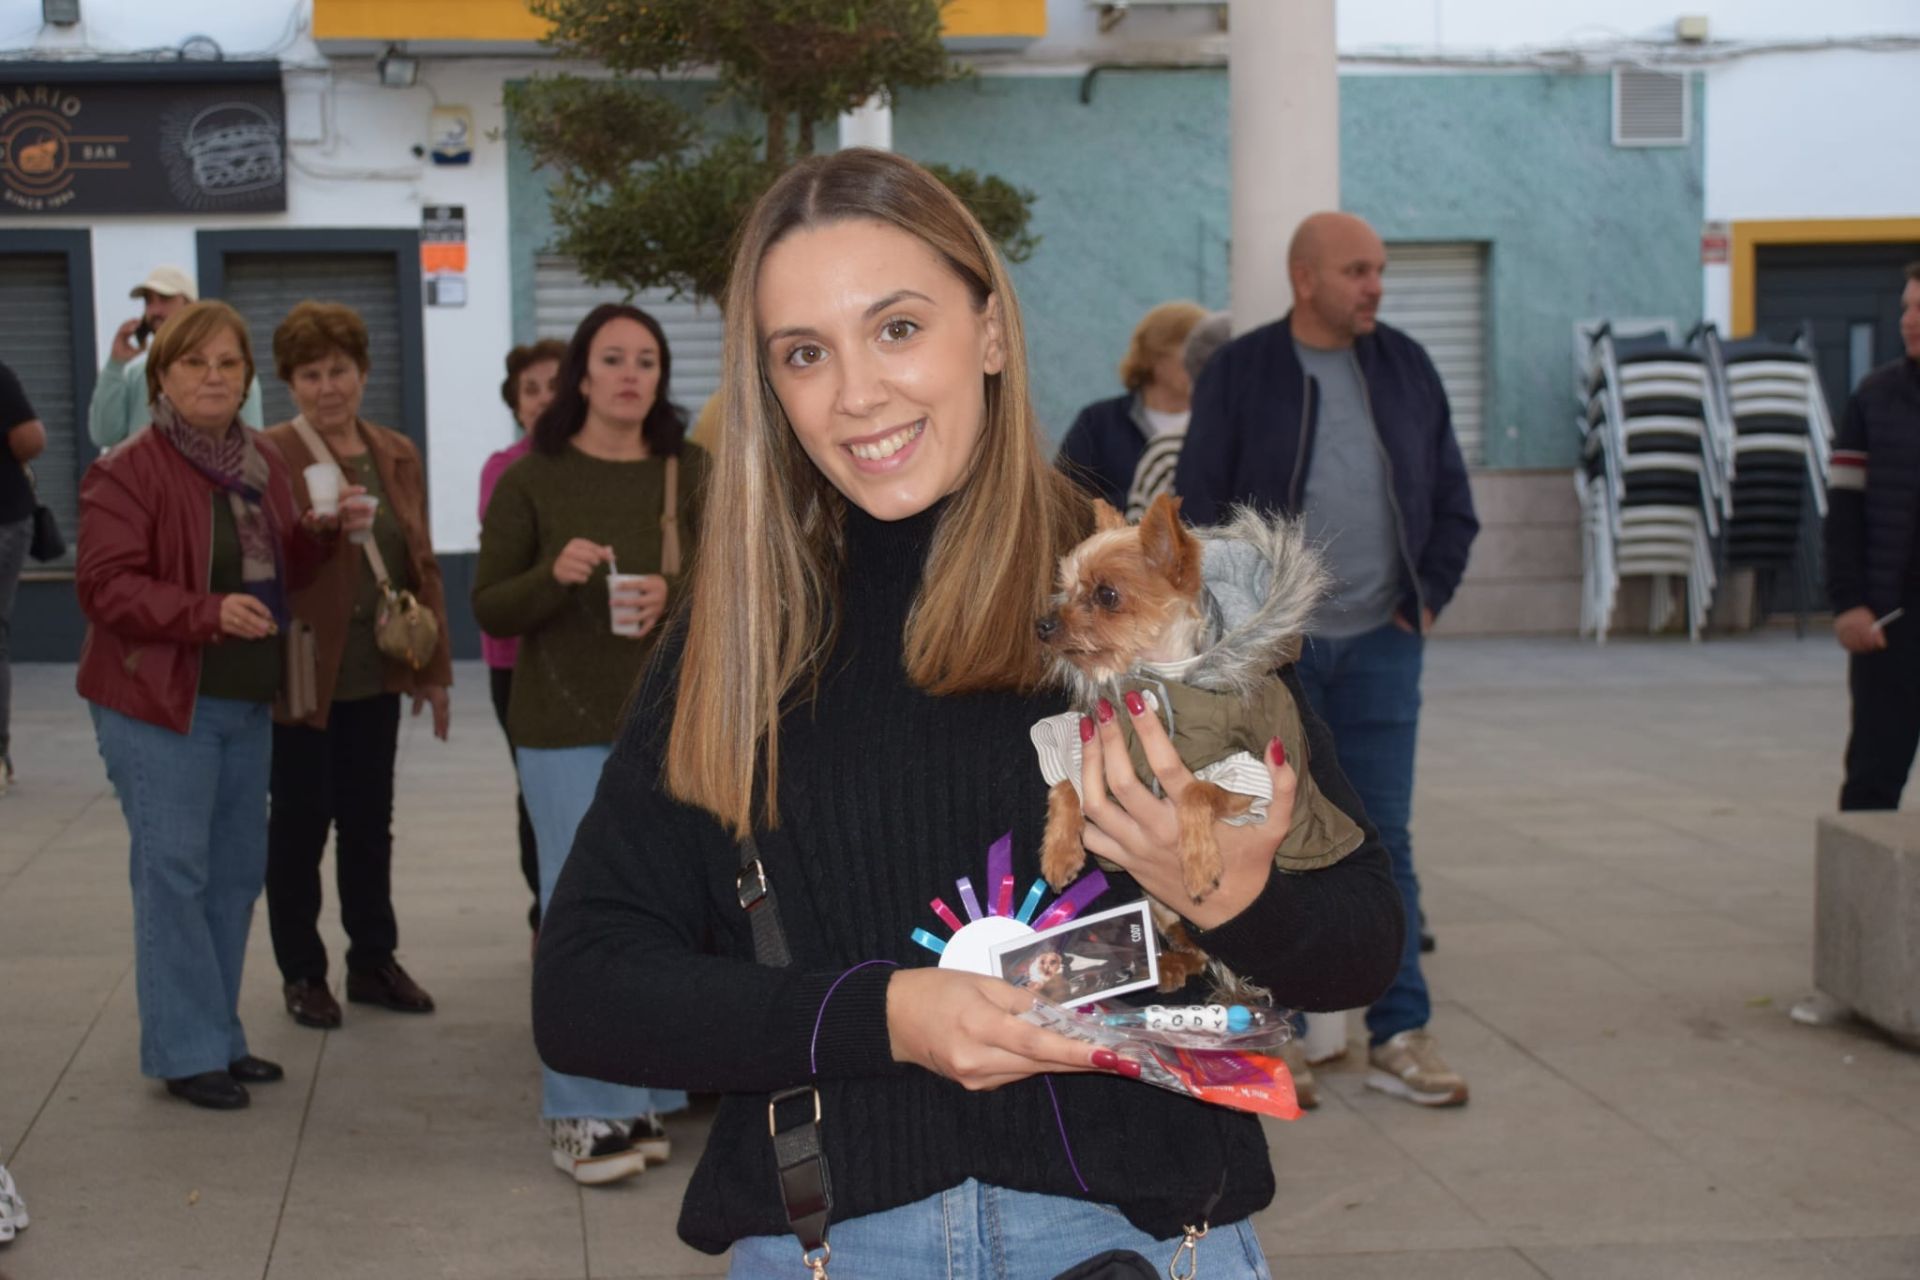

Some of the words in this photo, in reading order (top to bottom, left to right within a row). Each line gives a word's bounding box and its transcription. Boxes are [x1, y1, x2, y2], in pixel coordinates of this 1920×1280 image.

[82, 144, 117, 160] BAR
[1130, 924, 1142, 943] CODY
[1151, 1013, 1223, 1029] CODY
